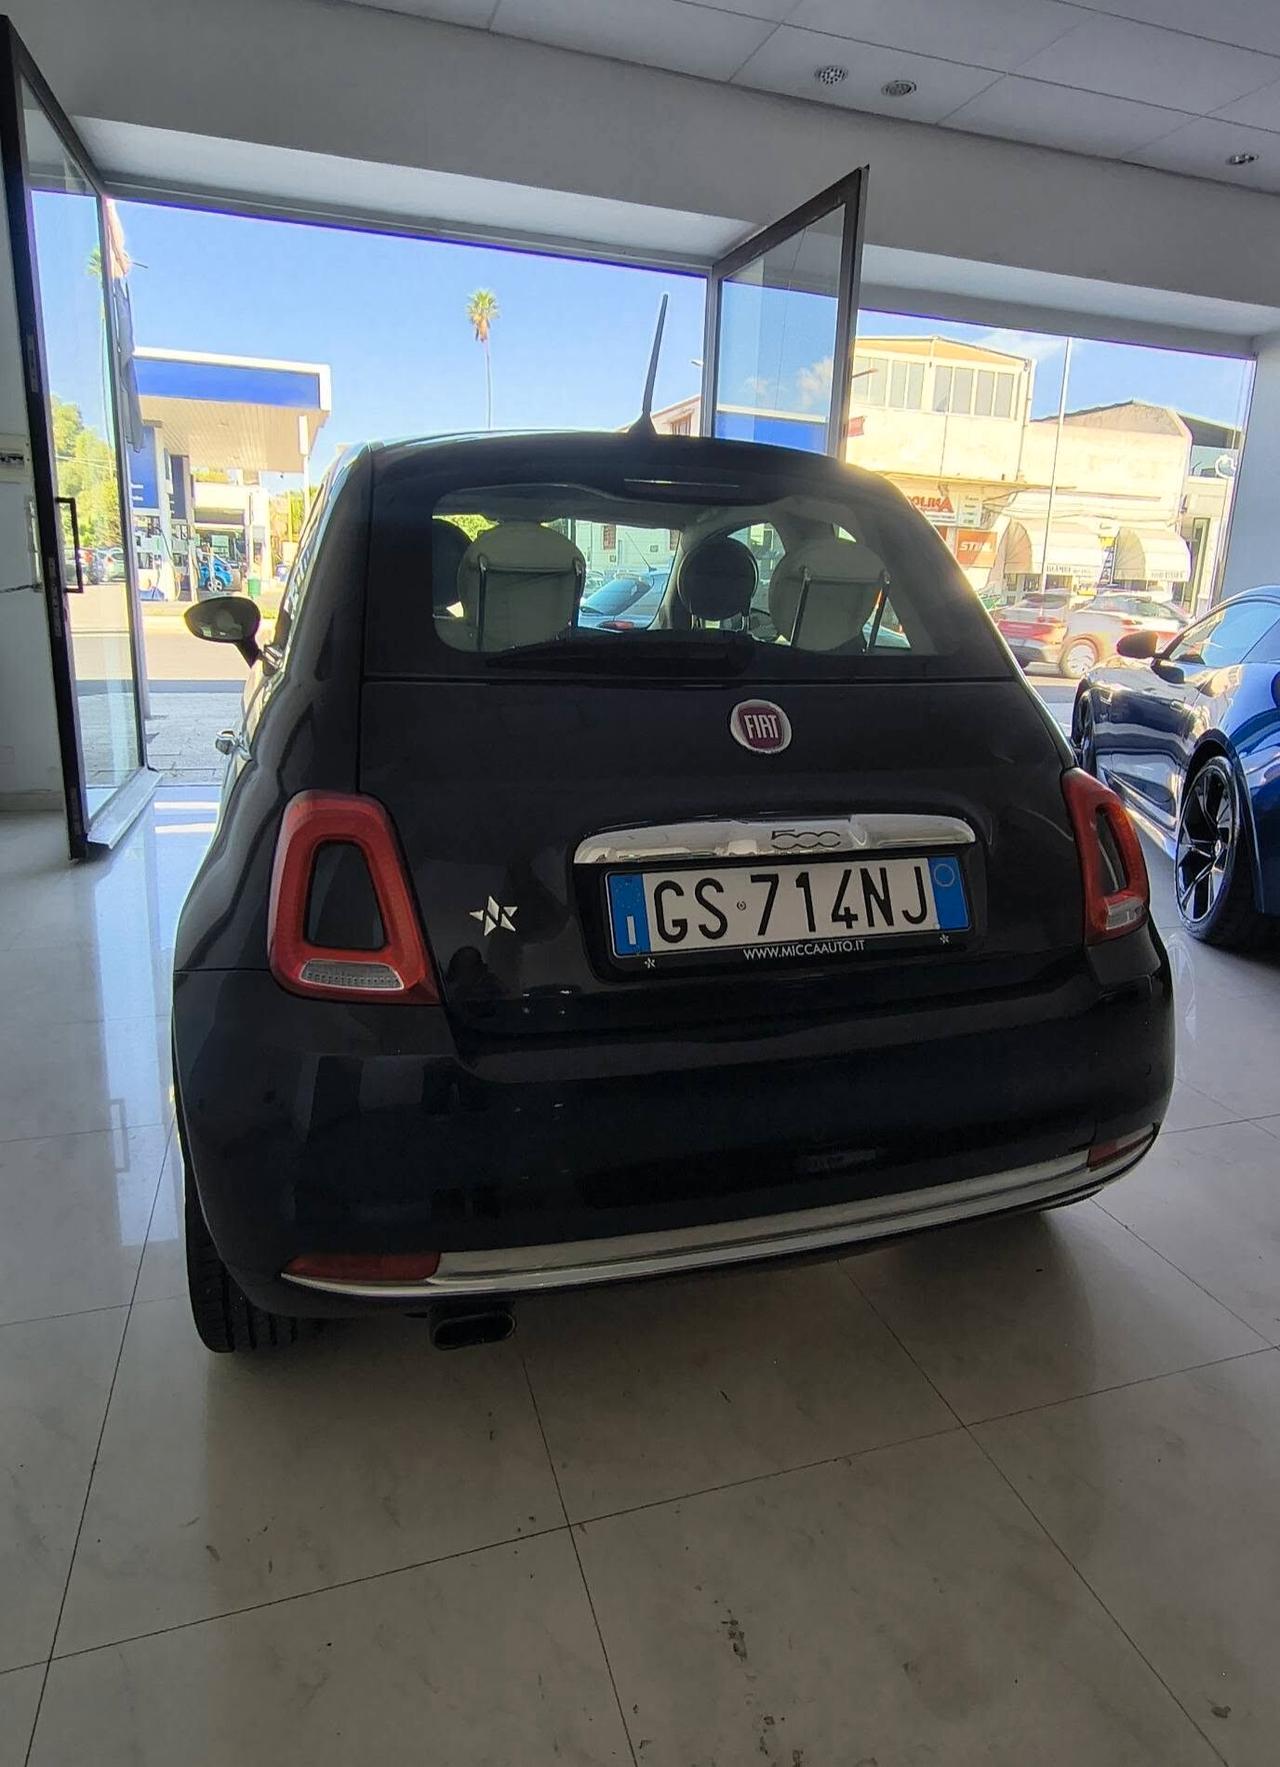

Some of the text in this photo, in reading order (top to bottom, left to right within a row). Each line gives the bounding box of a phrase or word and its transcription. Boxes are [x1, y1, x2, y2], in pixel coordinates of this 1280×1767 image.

[744, 714, 779, 739] FIAT
[771, 829, 841, 850] 500
[654, 877, 728, 943] GS
[750, 866, 928, 936] 714NJ
[743, 939, 866, 960] WWW.MICCAAUTO.IT
